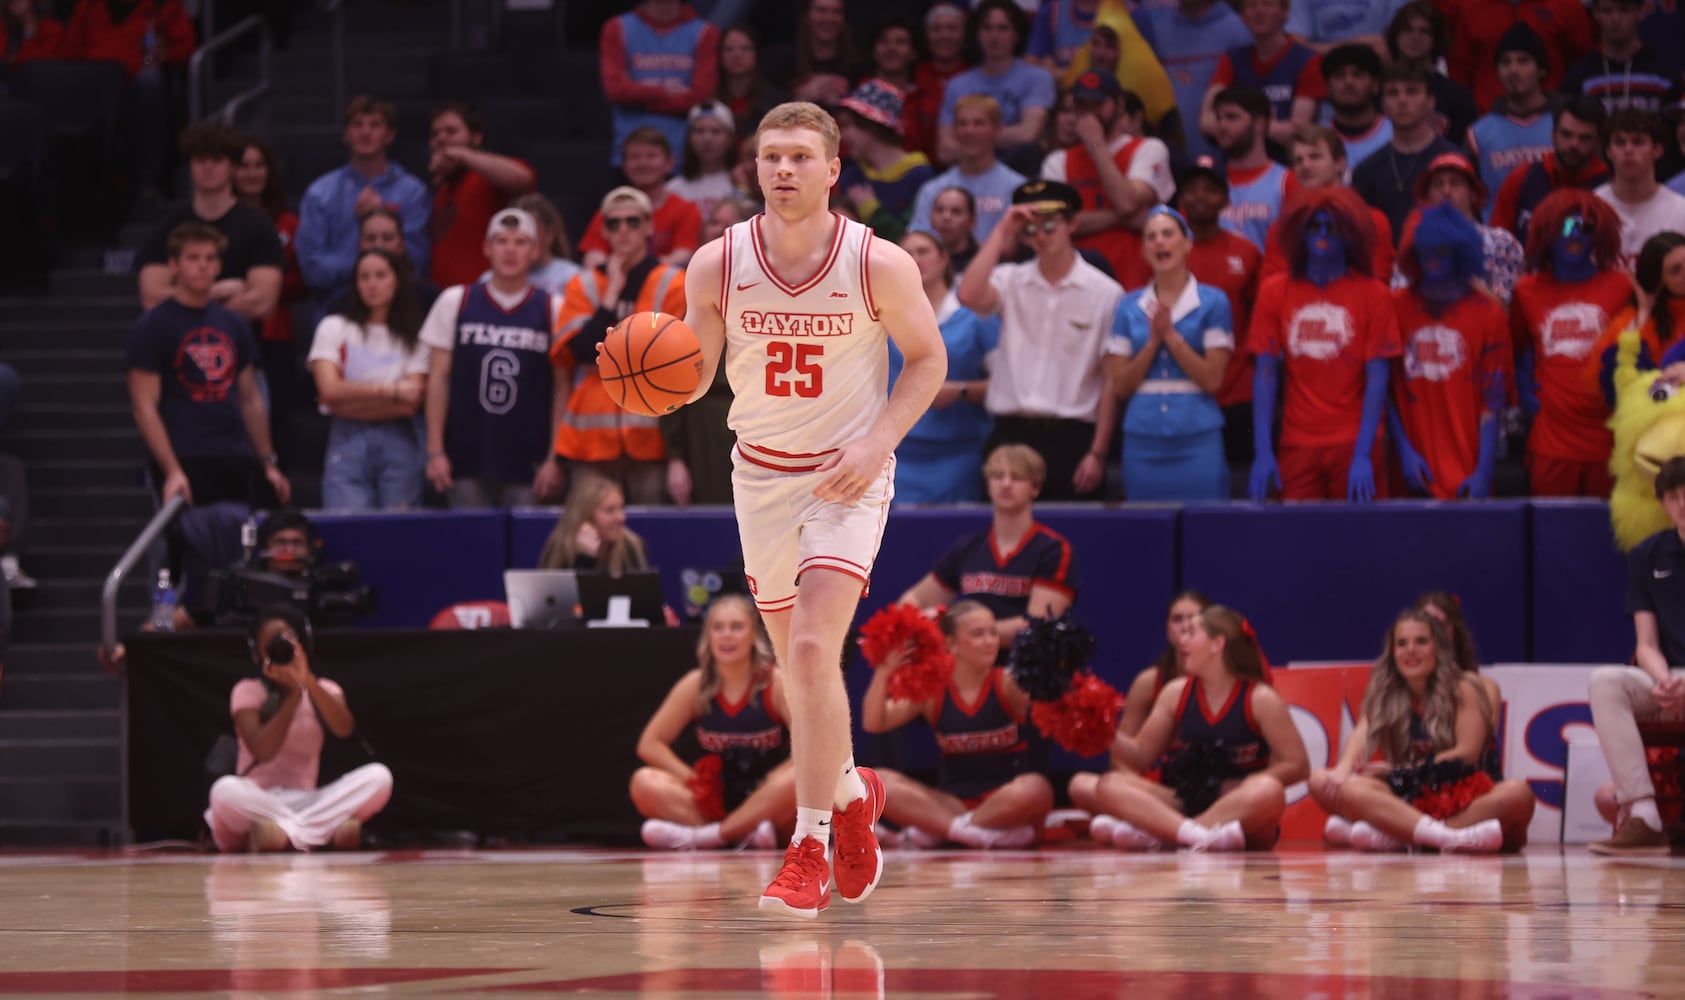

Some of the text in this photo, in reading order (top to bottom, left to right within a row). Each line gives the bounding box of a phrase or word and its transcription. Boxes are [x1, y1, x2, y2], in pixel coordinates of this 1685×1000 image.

[741, 311, 853, 336] DAYTON
[479, 348, 520, 415] 6
[765, 341, 824, 398] 25
